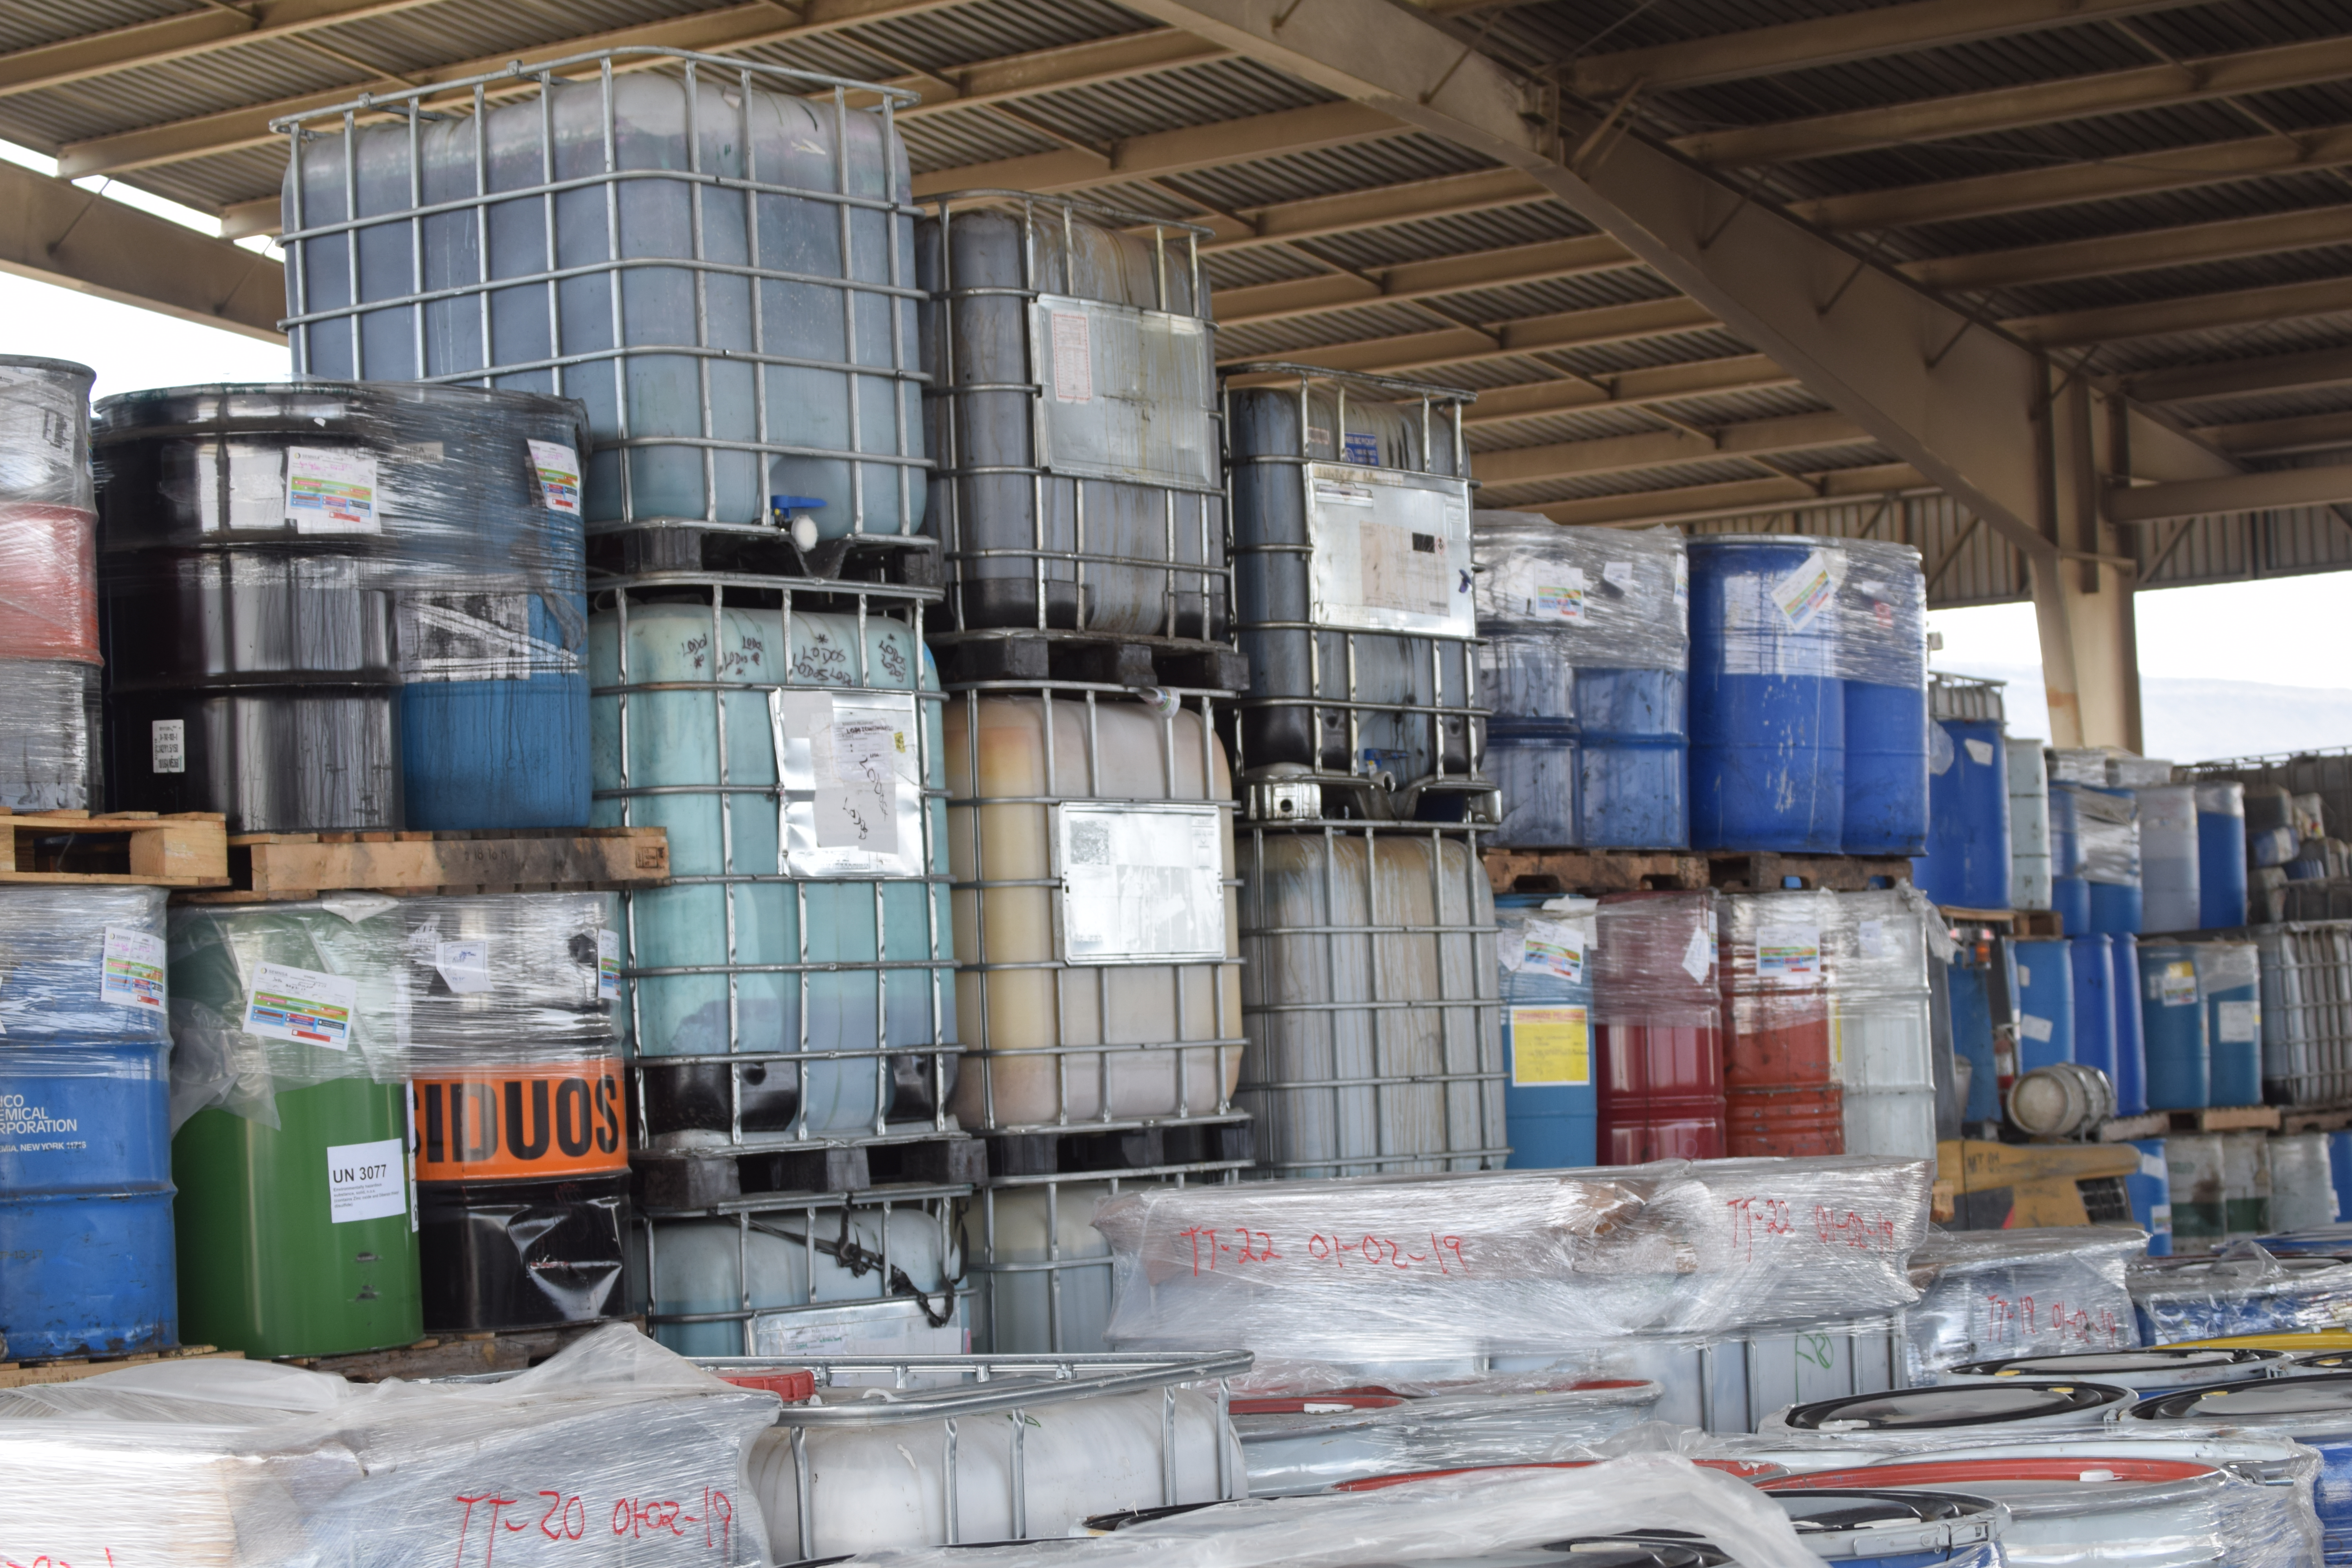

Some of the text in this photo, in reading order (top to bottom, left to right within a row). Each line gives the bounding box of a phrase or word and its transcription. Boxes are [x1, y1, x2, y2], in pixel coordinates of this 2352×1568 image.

[0, 1119, 77, 1135] RPORATION
[414, 1074, 619, 1163] IDUOS
[333, 1164, 387, 1183] UN 3077
[1180, 1226, 1471, 1277] TT-22 01-02-19
[1987, 1294, 2036, 1343] TT-19
[456, 1490, 585, 1568] TT-20
